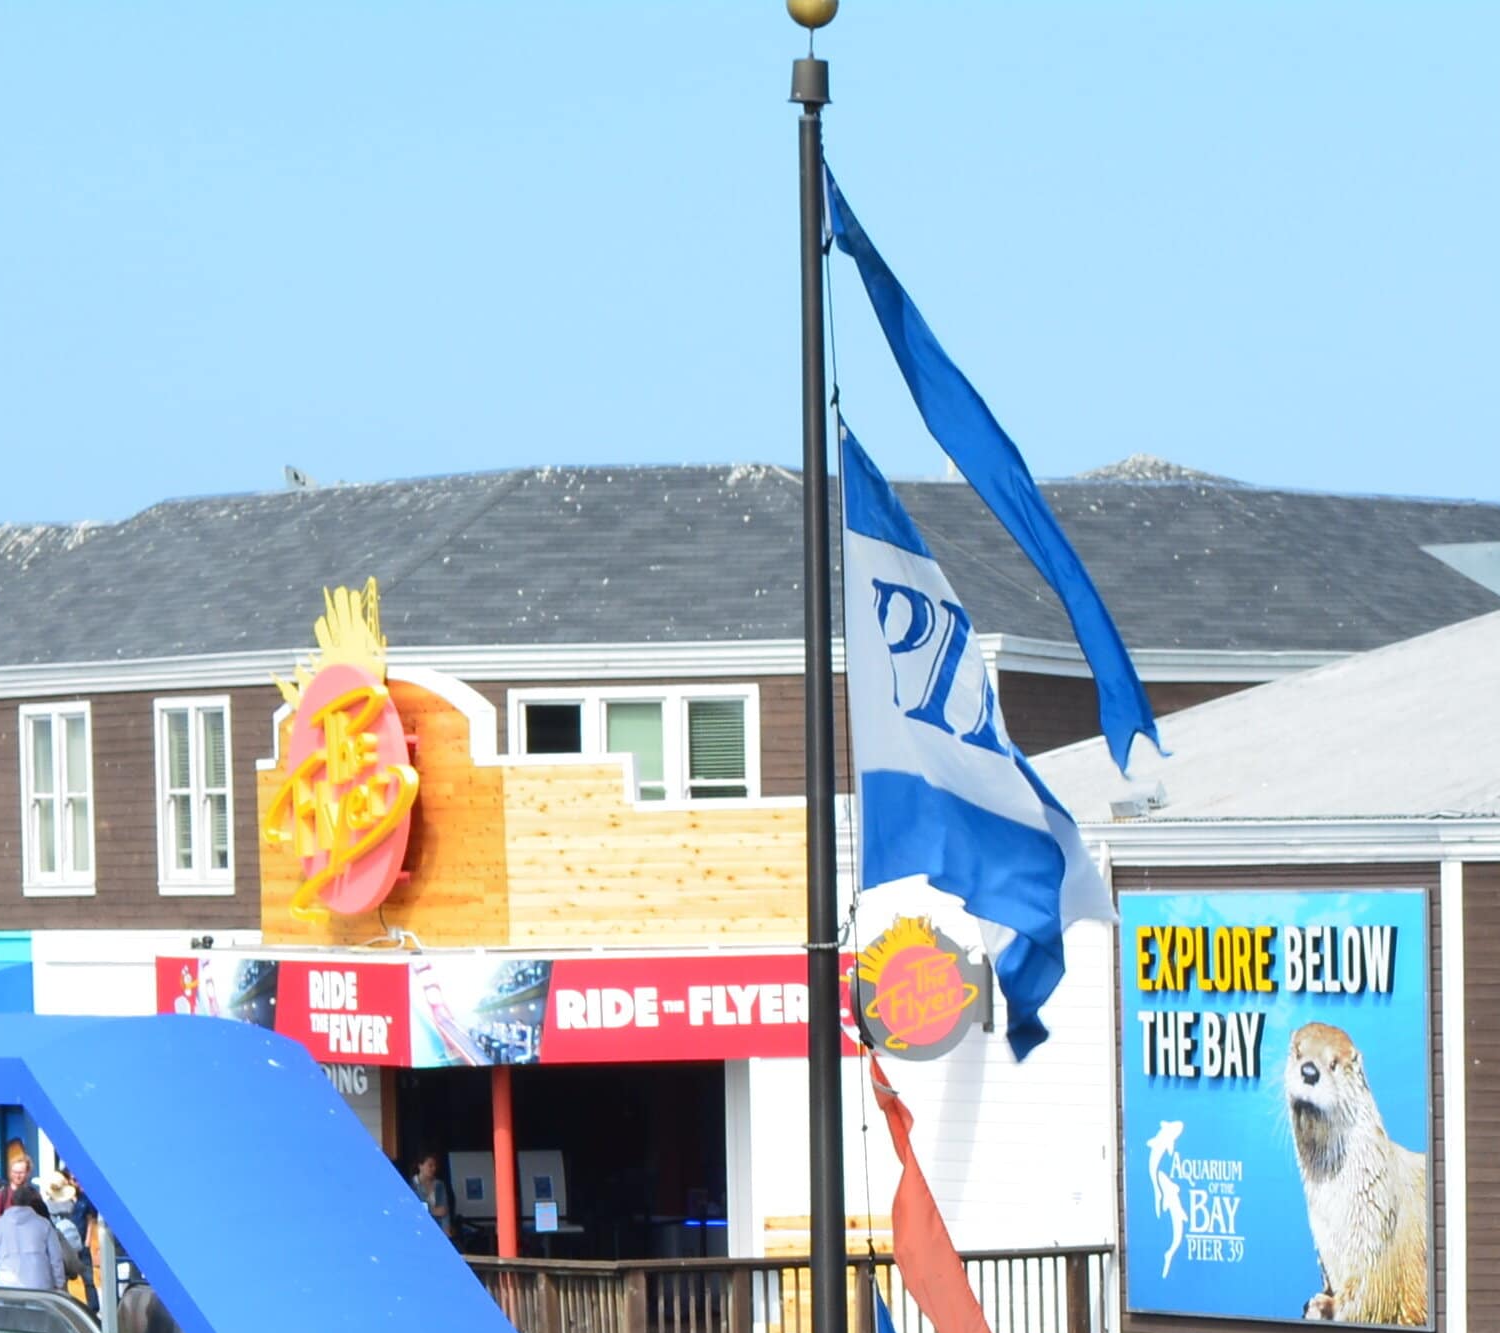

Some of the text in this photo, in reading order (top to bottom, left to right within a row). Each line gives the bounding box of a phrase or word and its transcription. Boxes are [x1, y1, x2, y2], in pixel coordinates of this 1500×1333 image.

[1136, 925, 1393, 994] EXPLORE BELOW
[309, 971, 359, 1010] RIDE
[556, 981, 809, 1030] RIDE THE FLYER
[311, 1013, 390, 1055] THE FLYER
[1138, 1011, 1261, 1078] THE BAY
[1170, 1152, 1243, 1187] AQUARIUM
[1190, 1190, 1240, 1235] BAY
[1187, 1238, 1245, 1262] PIER 39
